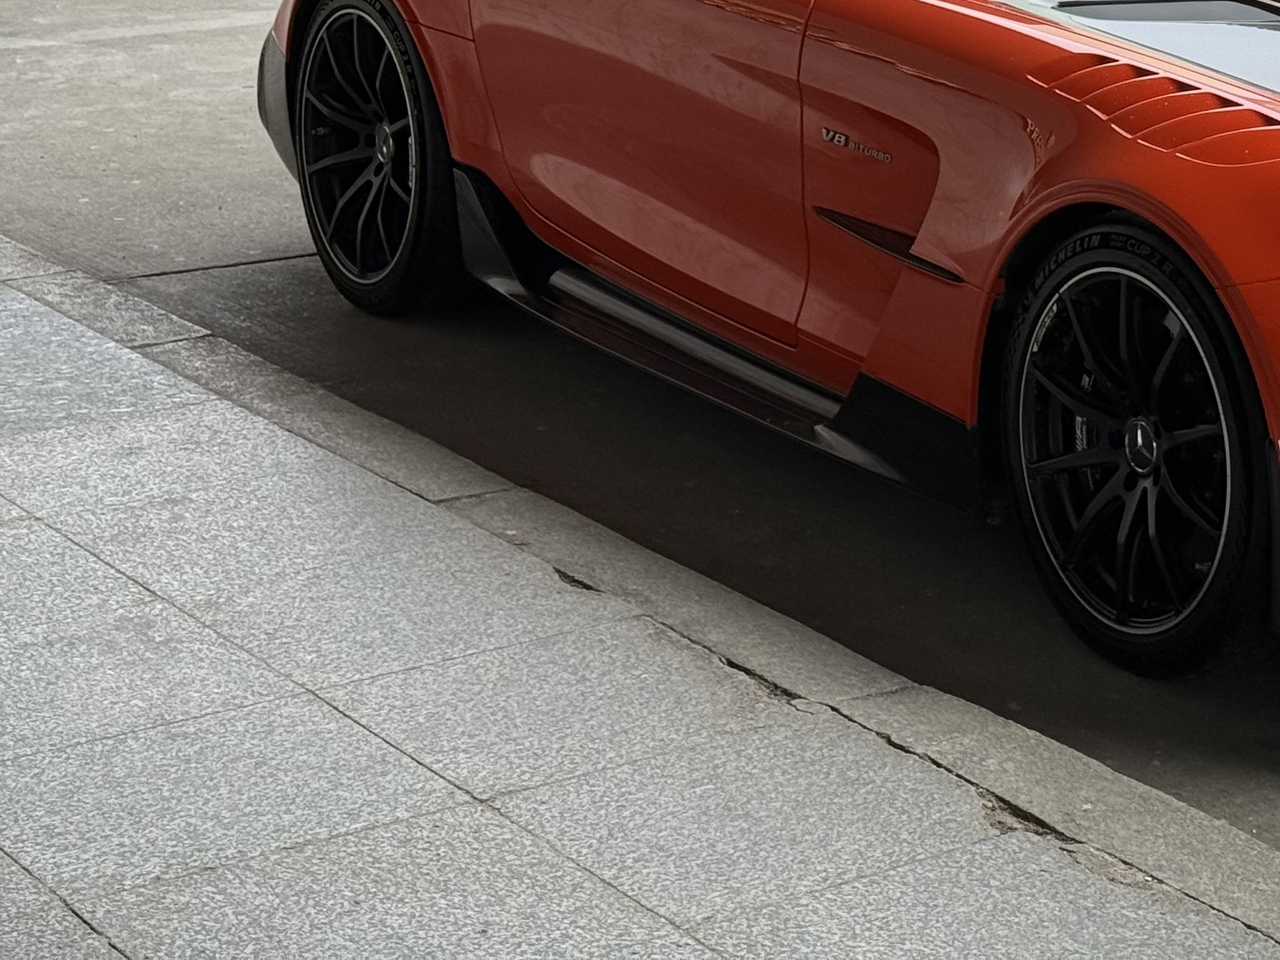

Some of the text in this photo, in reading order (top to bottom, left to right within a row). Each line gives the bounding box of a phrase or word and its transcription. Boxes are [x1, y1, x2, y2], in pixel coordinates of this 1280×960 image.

[821, 127, 892, 163] V8 BITURBO
[1035, 234, 1102, 291] MICHELIN
[1126, 238, 1152, 257] CUP
